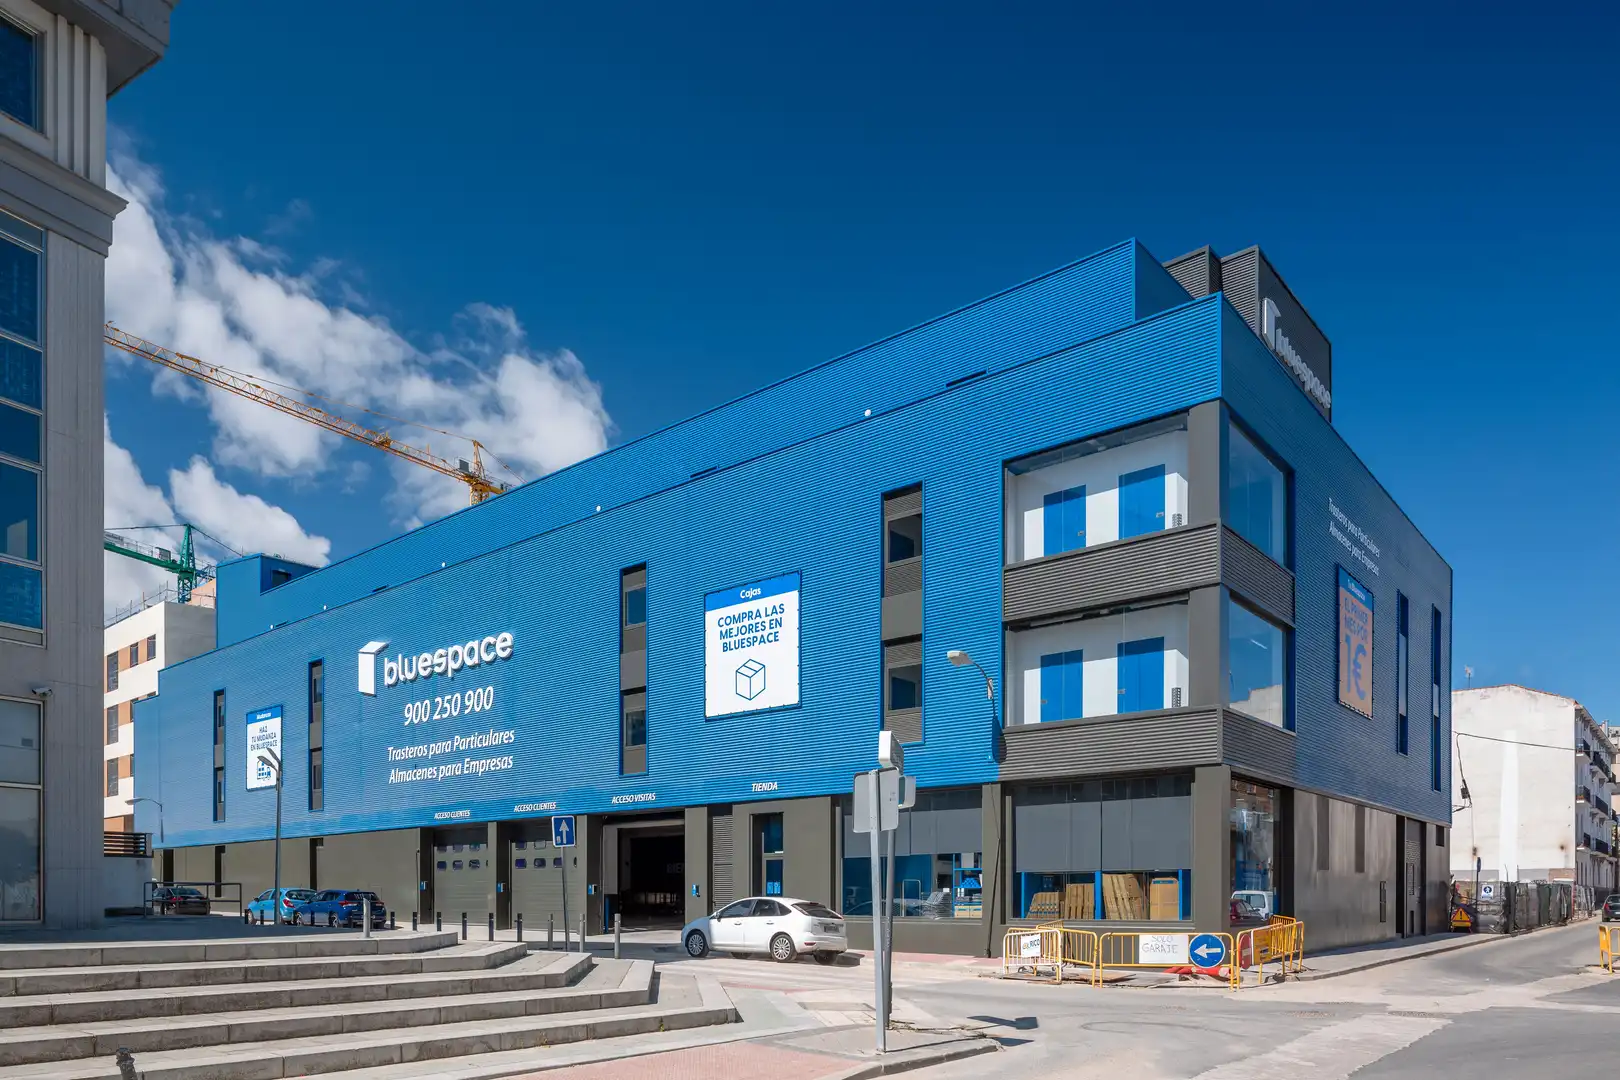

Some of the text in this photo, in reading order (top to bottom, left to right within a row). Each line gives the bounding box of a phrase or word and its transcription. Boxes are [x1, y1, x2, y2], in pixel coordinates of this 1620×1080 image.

[740, 588, 761, 599] Cajas
[718, 603, 785, 628] COMPRA LAS
[720, 617, 783, 640] MEJORES EN
[722, 631, 779, 652] BLUESPACE
[384, 632, 514, 687] bluespace
[404, 686, 494, 726] 900 250 900
[387, 728, 515, 762] Trasteros para Particulares
[389, 755, 513, 784] Almacenes para Empresas
[752, 782, 778, 792] TIENDA
[514, 802, 556, 812] ACCESO CLIENTES
[612, 793, 656, 804] ACCESO VISITAS
[434, 812, 450, 820] ACCESO
[1142, 943, 1179, 955] GARAJE
